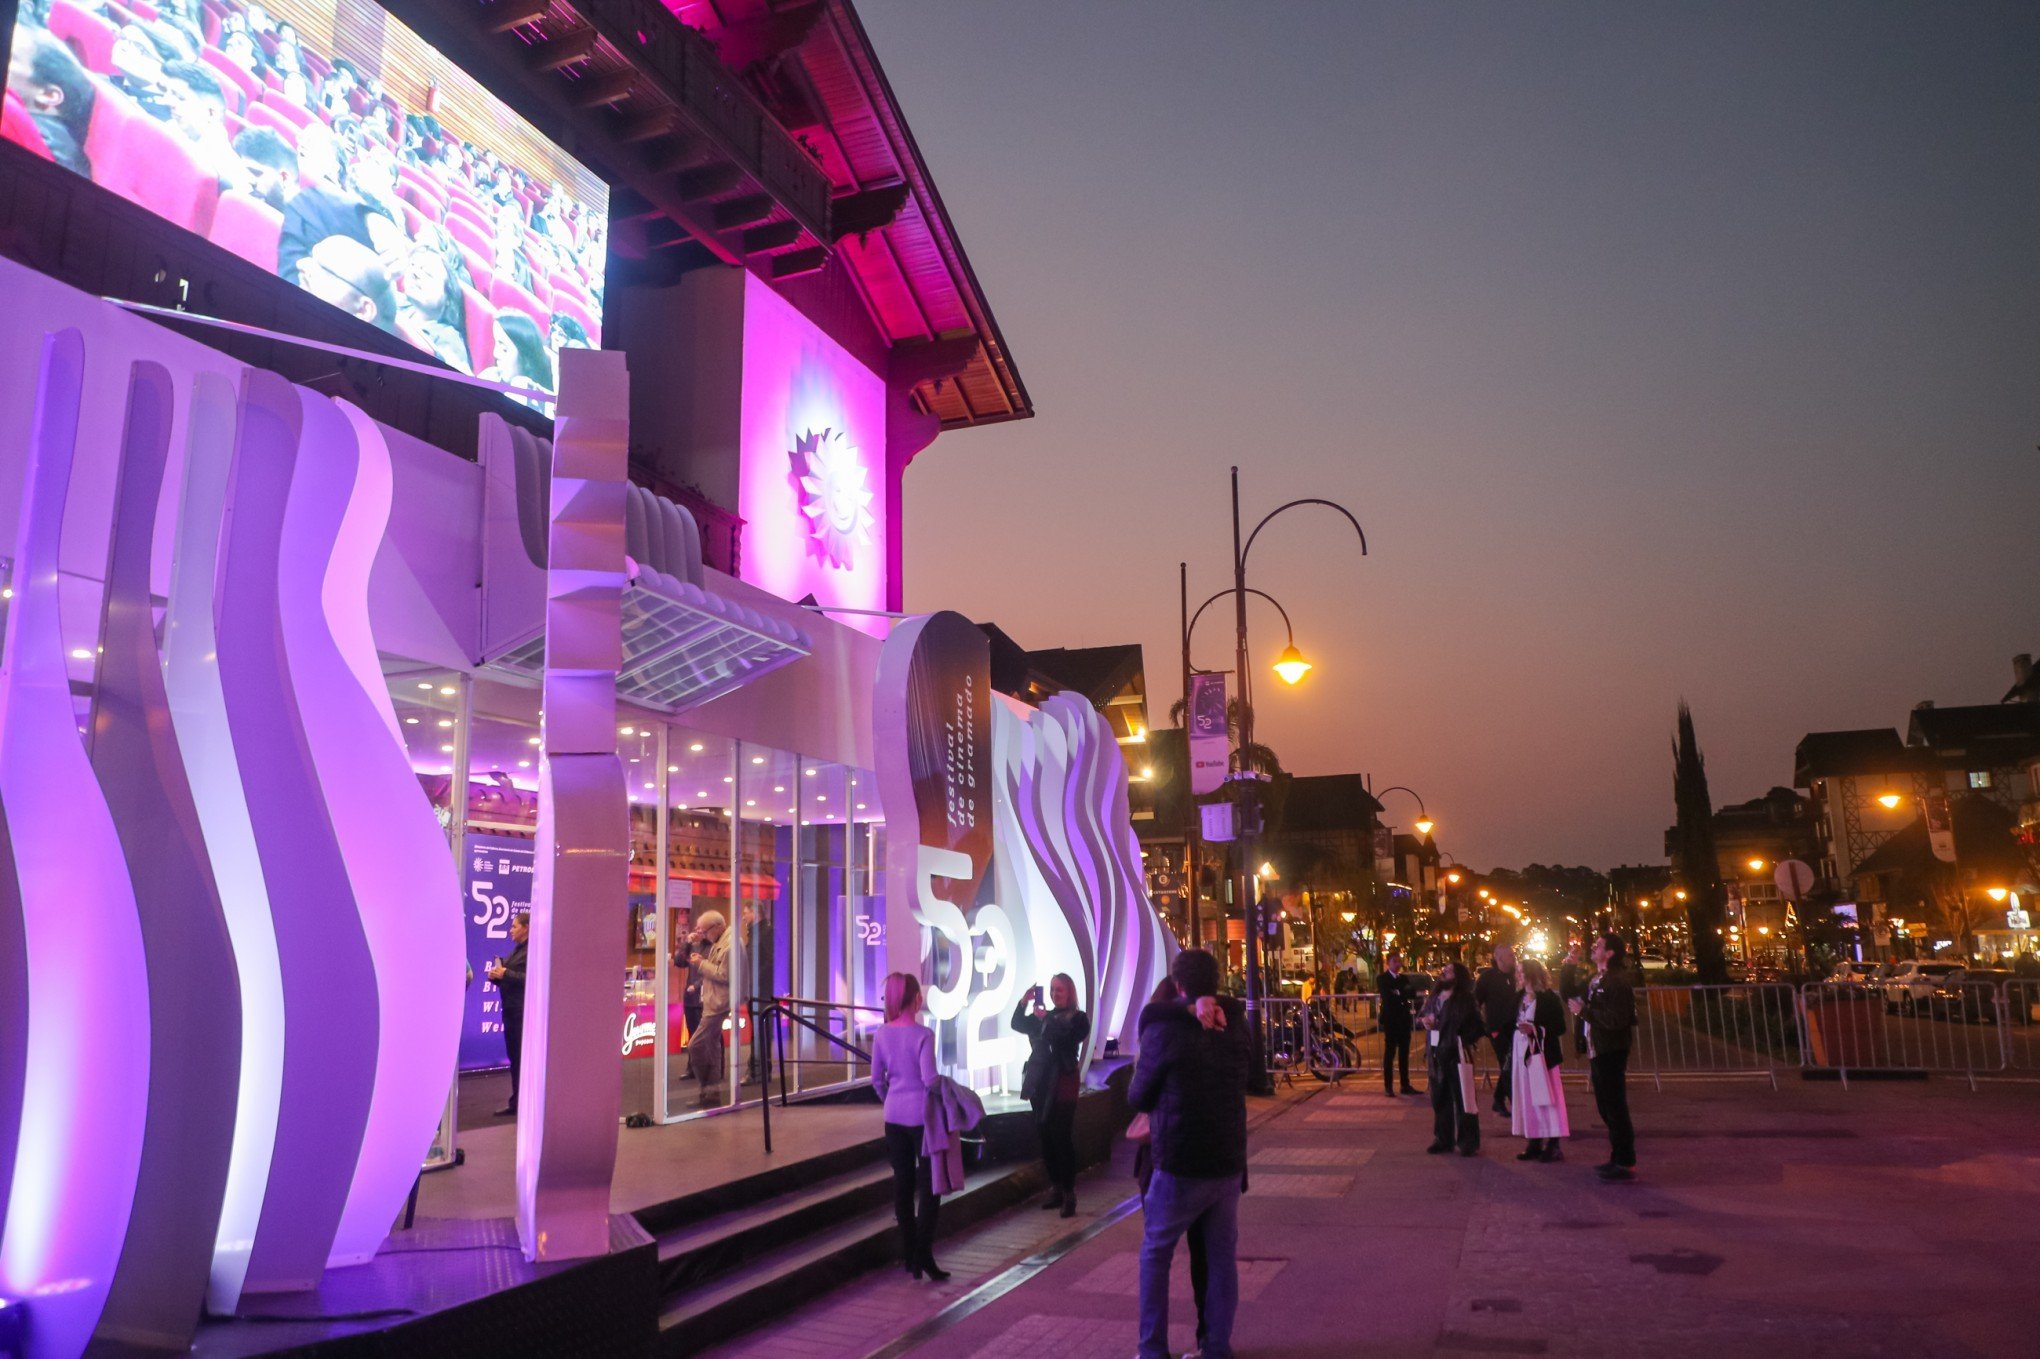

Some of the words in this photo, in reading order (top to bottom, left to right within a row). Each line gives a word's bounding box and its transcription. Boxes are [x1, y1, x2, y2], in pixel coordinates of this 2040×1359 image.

[957, 693, 965, 785] cinema
[964, 675, 975, 788] gramado
[1197, 715, 1212, 730] 52
[946, 722, 957, 827] festival
[1206, 759, 1224, 768] YouTube
[957, 796, 965, 826] de
[967, 798, 975, 828] de
[471, 880, 510, 938] 52
[855, 915, 882, 946] 52
[916, 844, 1017, 1070] 52
